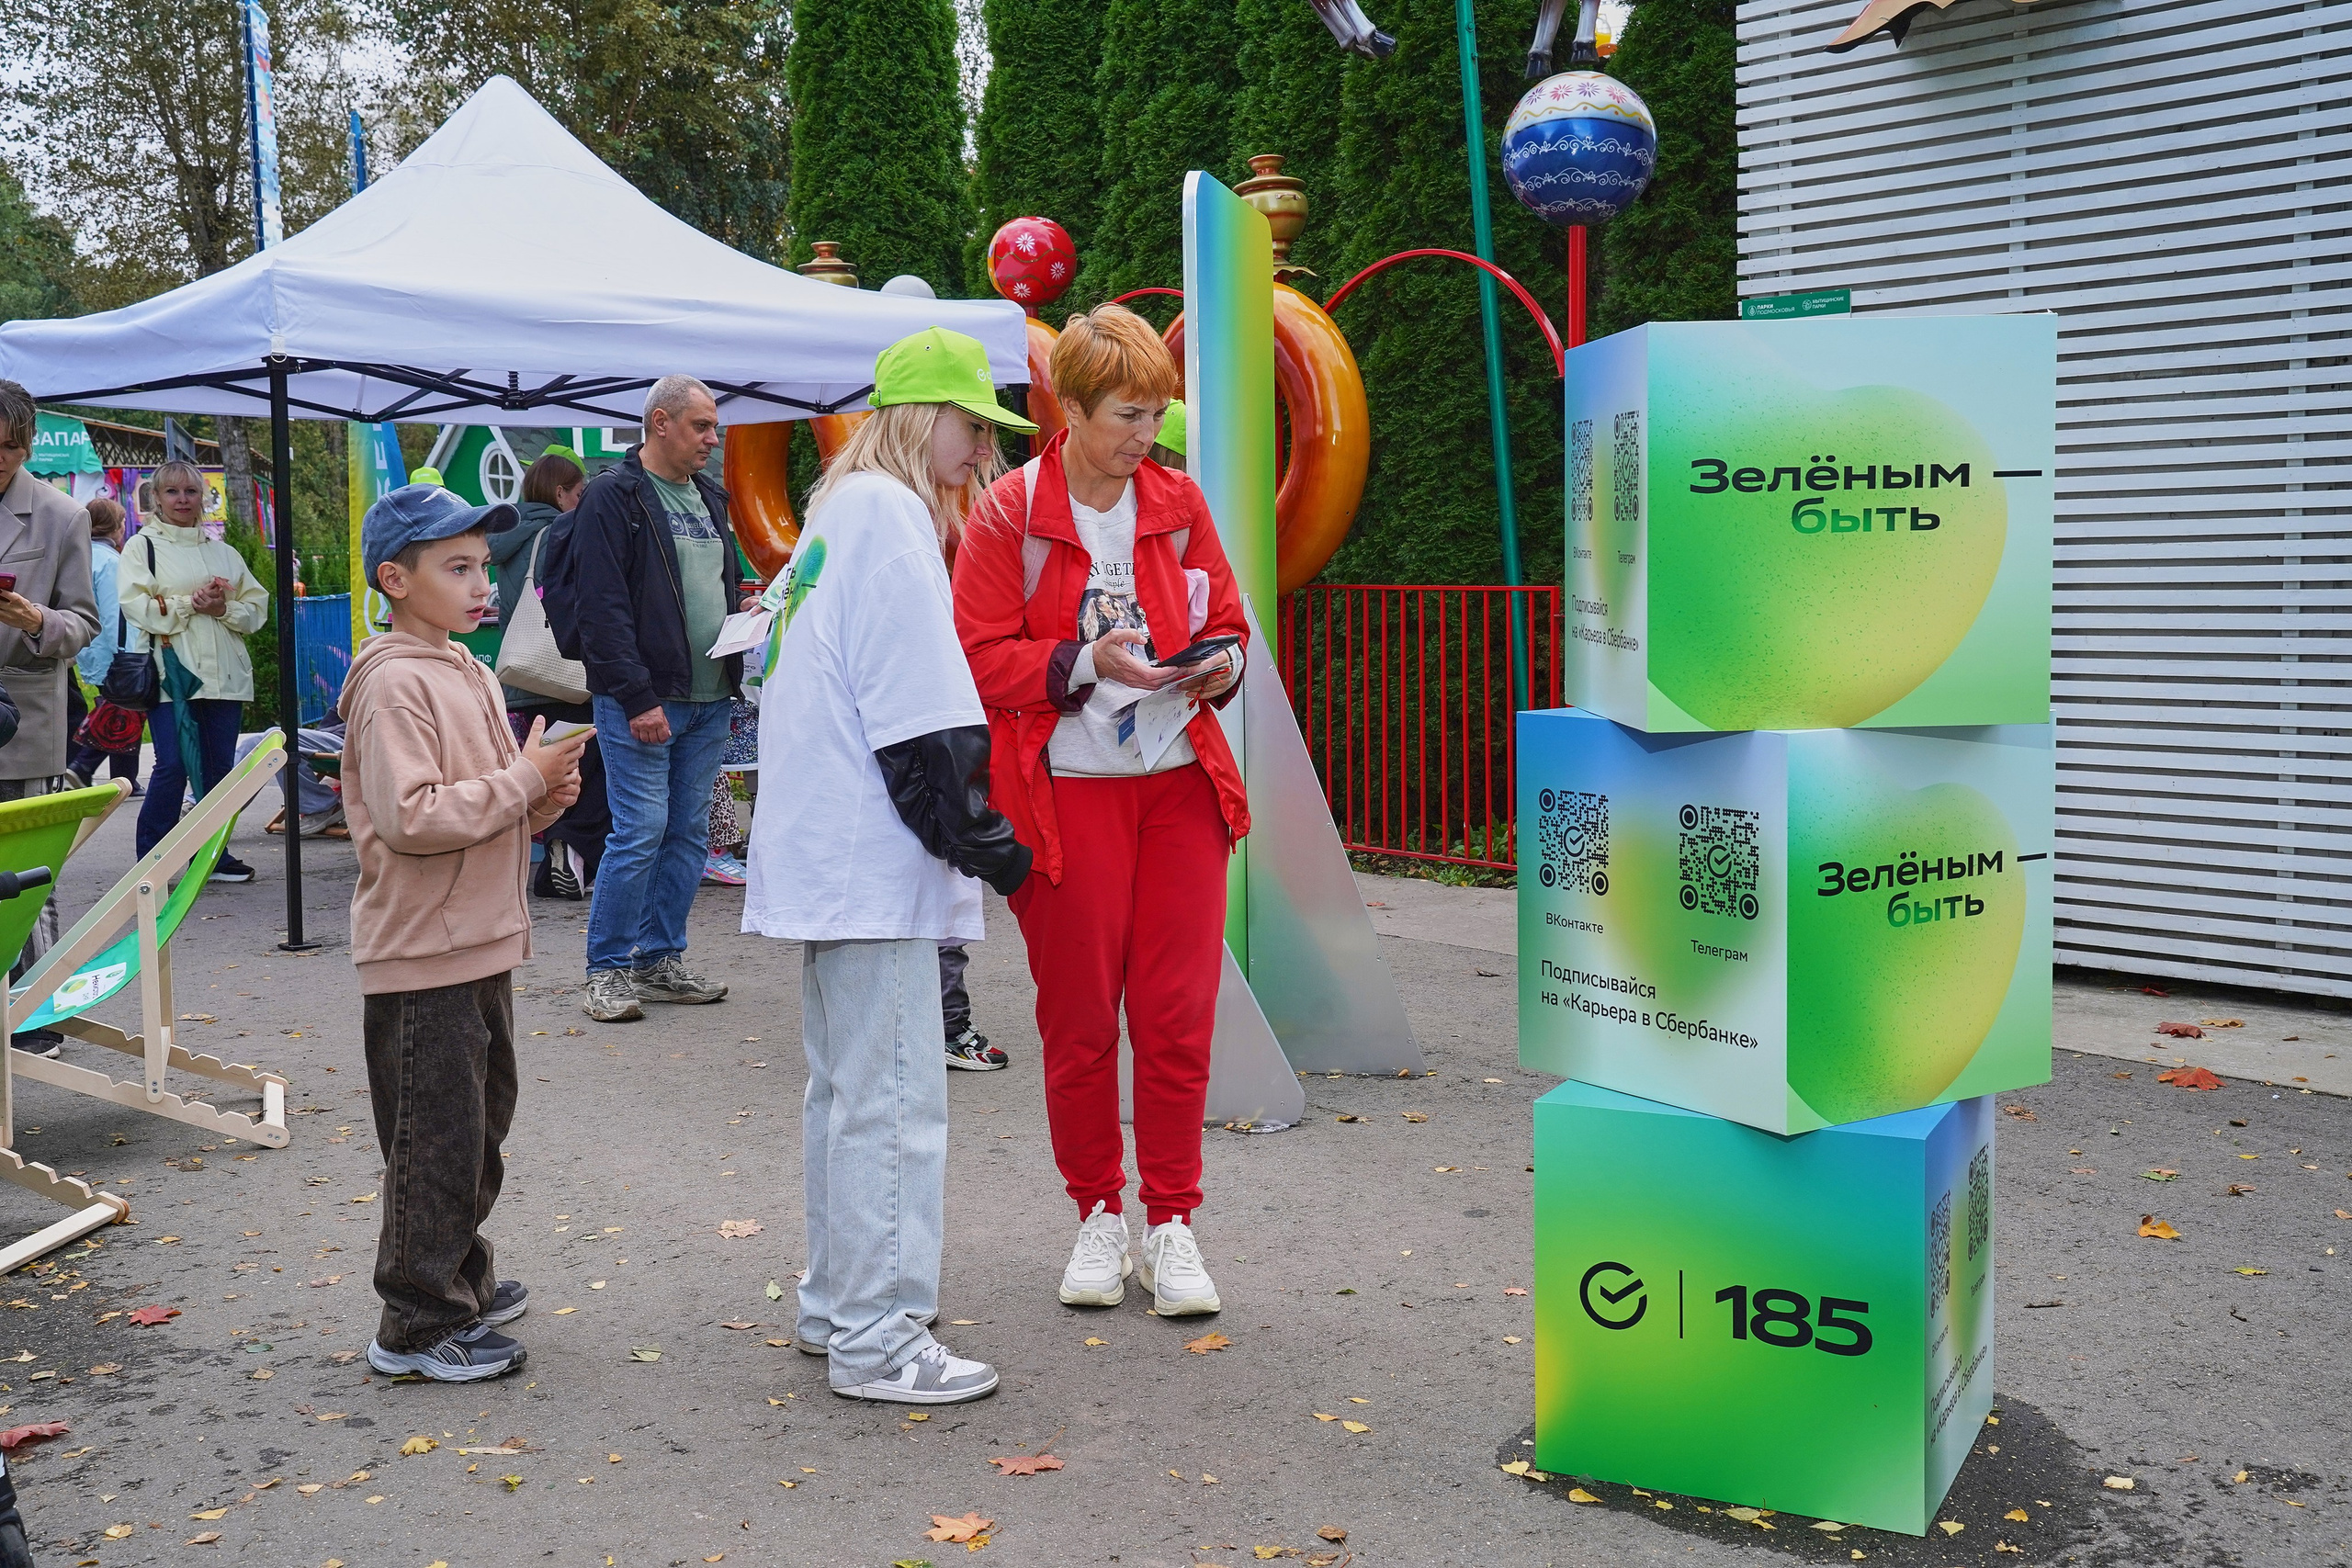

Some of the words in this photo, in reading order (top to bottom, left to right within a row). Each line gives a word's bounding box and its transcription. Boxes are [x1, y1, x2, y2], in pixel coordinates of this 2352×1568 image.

[1812, 296, 1845, 304] МЫТИЩИНСКИЕ
[1690, 455, 1971, 494] Зелёным
[1792, 497, 1940, 534] быть
[1573, 547, 1592, 559] ВКонтакте
[1617, 550, 1636, 567] Телеграм
[1571, 594, 1609, 616] Подписывайся
[1571, 626, 1578, 638] на
[1578, 624, 1602, 647] «Карьера
[1602, 632, 1607, 645] в
[1607, 627, 1639, 652] Сбербанке»
[1817, 850, 2003, 897] Зелёным
[1545, 912, 1604, 934] ВКонтакте
[1887, 891, 1984, 928] быть
[1690, 939, 1748, 963] Телеграм
[1541, 959, 1657, 999] Подписывайся
[1541, 990, 1558, 1007] на
[1563, 993, 1637, 1024] «Карьера
[1642, 1012, 1651, 1026] в
[1656, 1011, 1758, 1049] Сбербанке»
[1971, 1272, 1986, 1298] Телеграм
[1715, 1284, 1873, 1357] 185
[1931, 1325, 1949, 1359] ВКонтакте
[1930, 1353, 1963, 1419] Подписывайся
[1930, 1432, 1937, 1449] на
[1936, 1394, 1958, 1434] «Карьера
[1958, 1384, 1962, 1398] в
[1961, 1344, 1988, 1392] Сбербанке»
